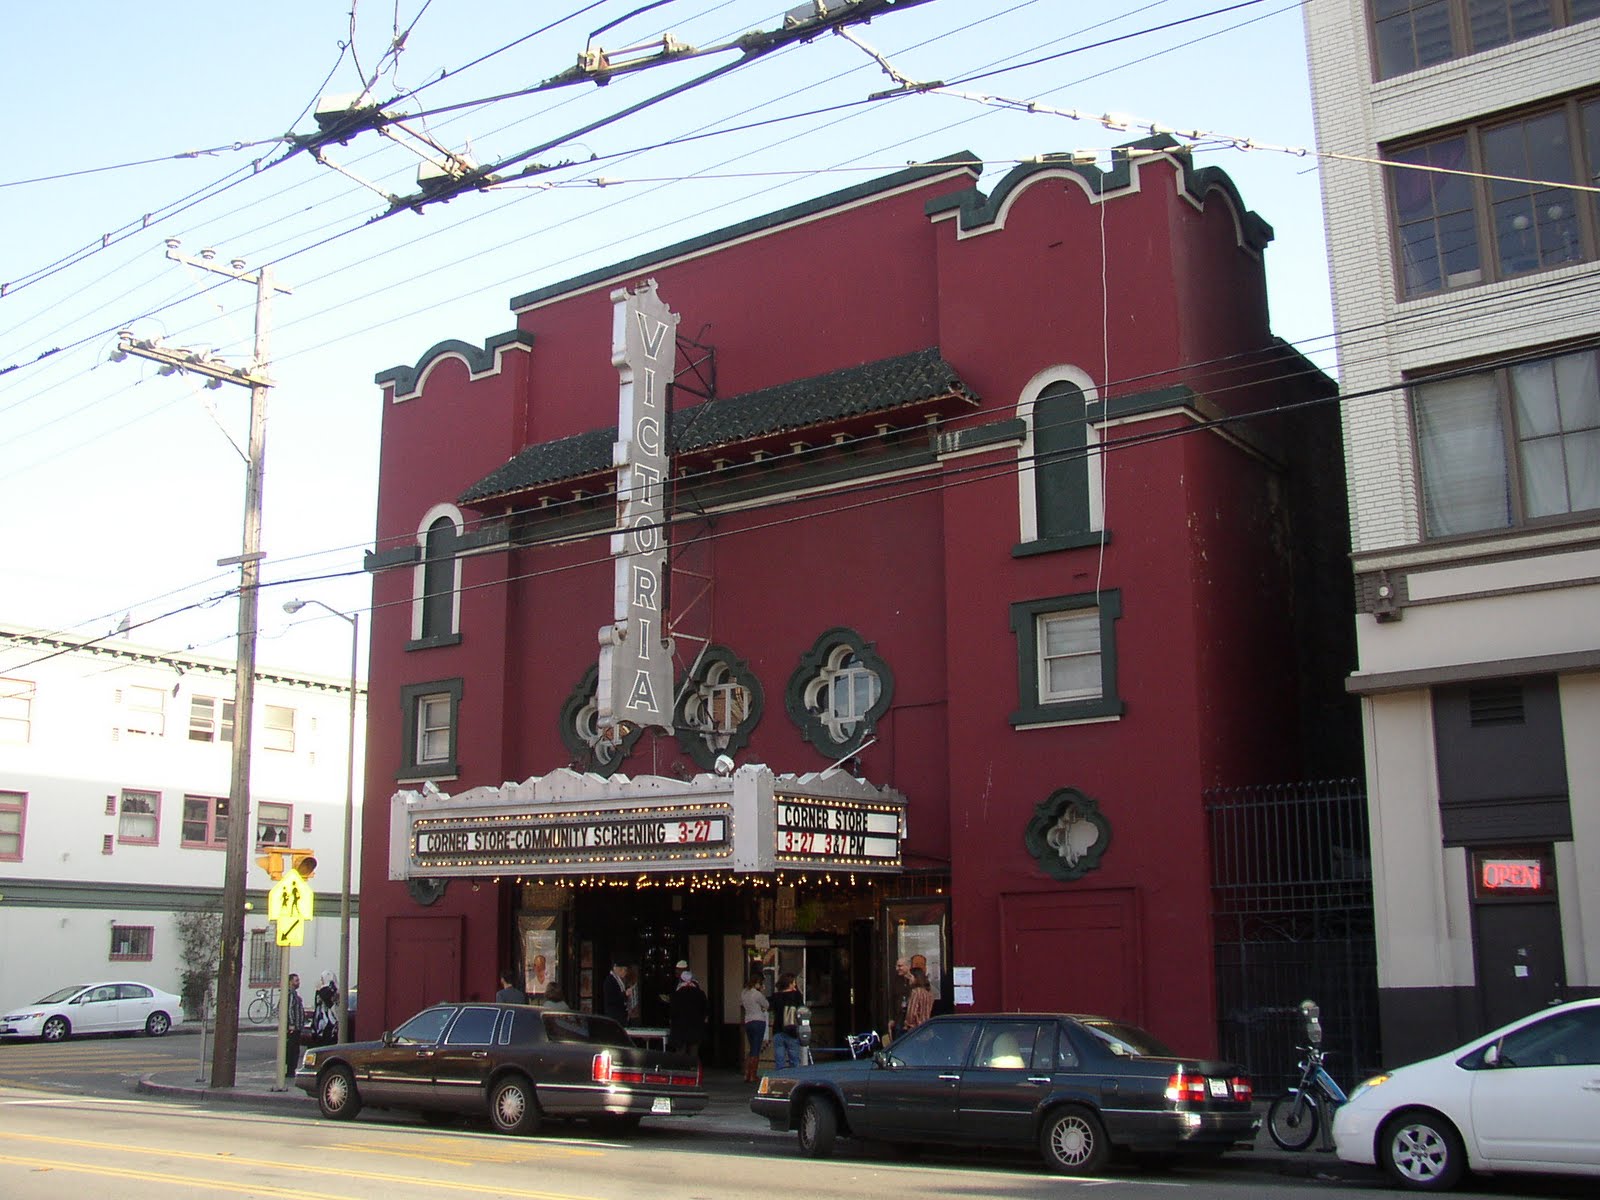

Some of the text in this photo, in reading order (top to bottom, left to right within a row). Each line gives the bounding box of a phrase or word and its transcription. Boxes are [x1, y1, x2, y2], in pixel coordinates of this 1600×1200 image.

[626, 309, 669, 713] VICTORIA
[785, 806, 868, 832] CORNER STORE
[427, 832, 469, 852] CORNER
[594, 822, 666, 846] SCREENING
[678, 820, 711, 844] 3-27
[785, 831, 815, 853] 3-27
[1482, 863, 1540, 889] OPEN
